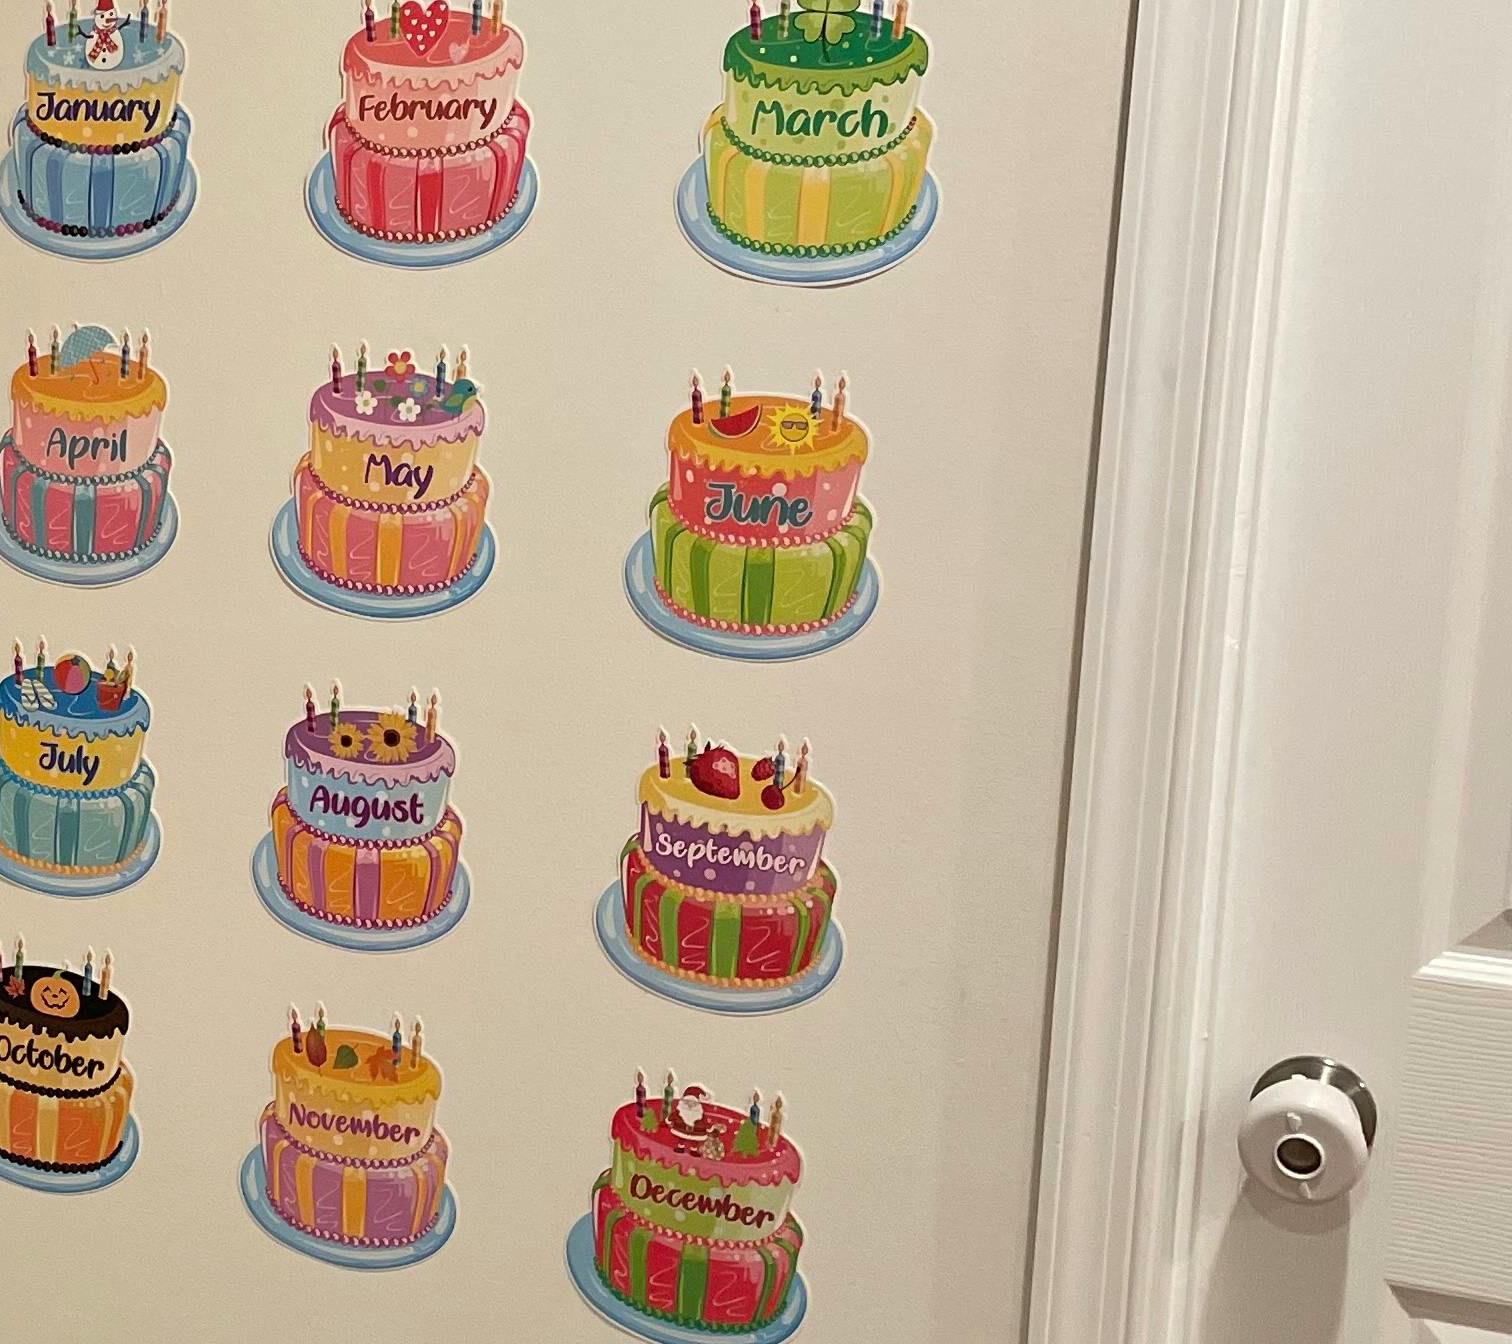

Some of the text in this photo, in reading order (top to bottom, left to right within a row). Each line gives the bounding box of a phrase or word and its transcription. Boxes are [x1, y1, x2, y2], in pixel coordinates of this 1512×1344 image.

[35, 91, 162, 133] January
[358, 93, 498, 132] February
[751, 99, 889, 138] March
[45, 427, 128, 468] April
[364, 453, 434, 500] May
[705, 482, 813, 528] June
[38, 741, 100, 784] July
[309, 784, 425, 828] August
[655, 832, 806, 875] September
[289, 1101, 420, 1146] November
[629, 1173, 775, 1229] December
